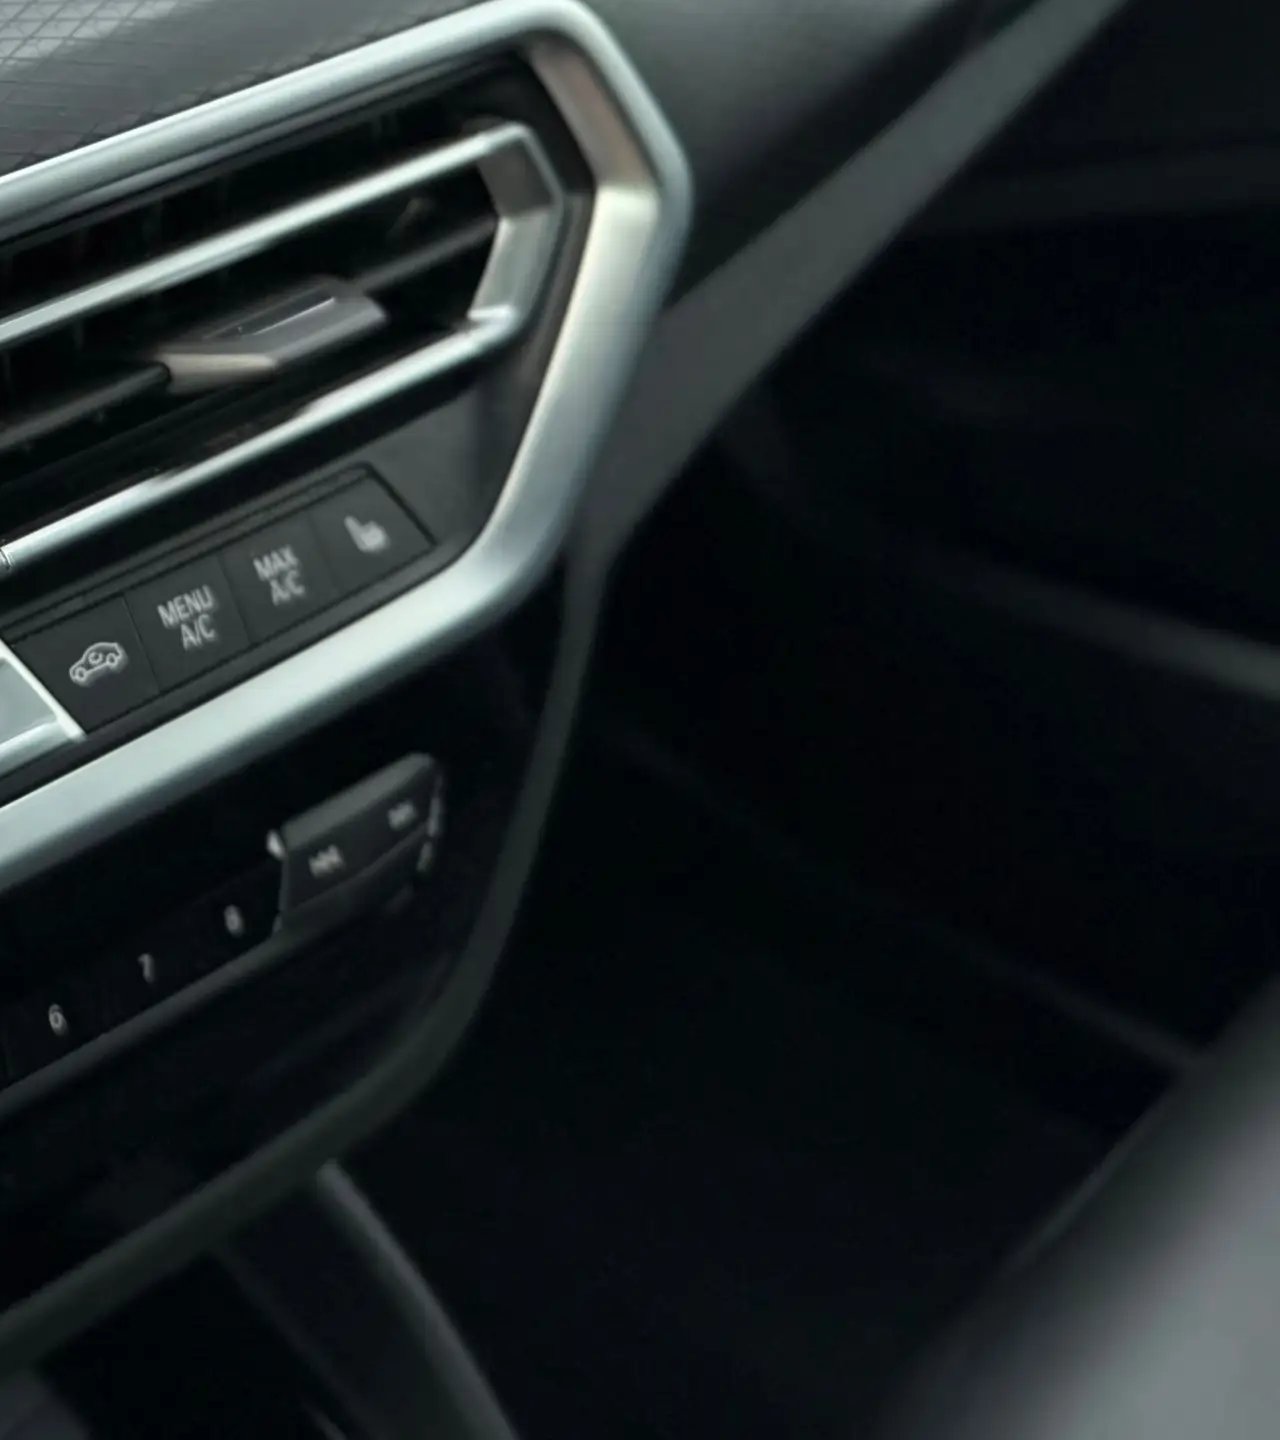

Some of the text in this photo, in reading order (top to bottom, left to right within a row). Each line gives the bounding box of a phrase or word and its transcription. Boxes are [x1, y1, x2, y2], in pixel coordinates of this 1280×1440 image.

[252, 545, 299, 580] MAX
[157, 585, 218, 629] MENU
[269, 575, 306, 606] A/C
[180, 615, 217, 651] A/C
[138, 952, 156, 984] 7
[45, 1002, 67, 1036] 6
